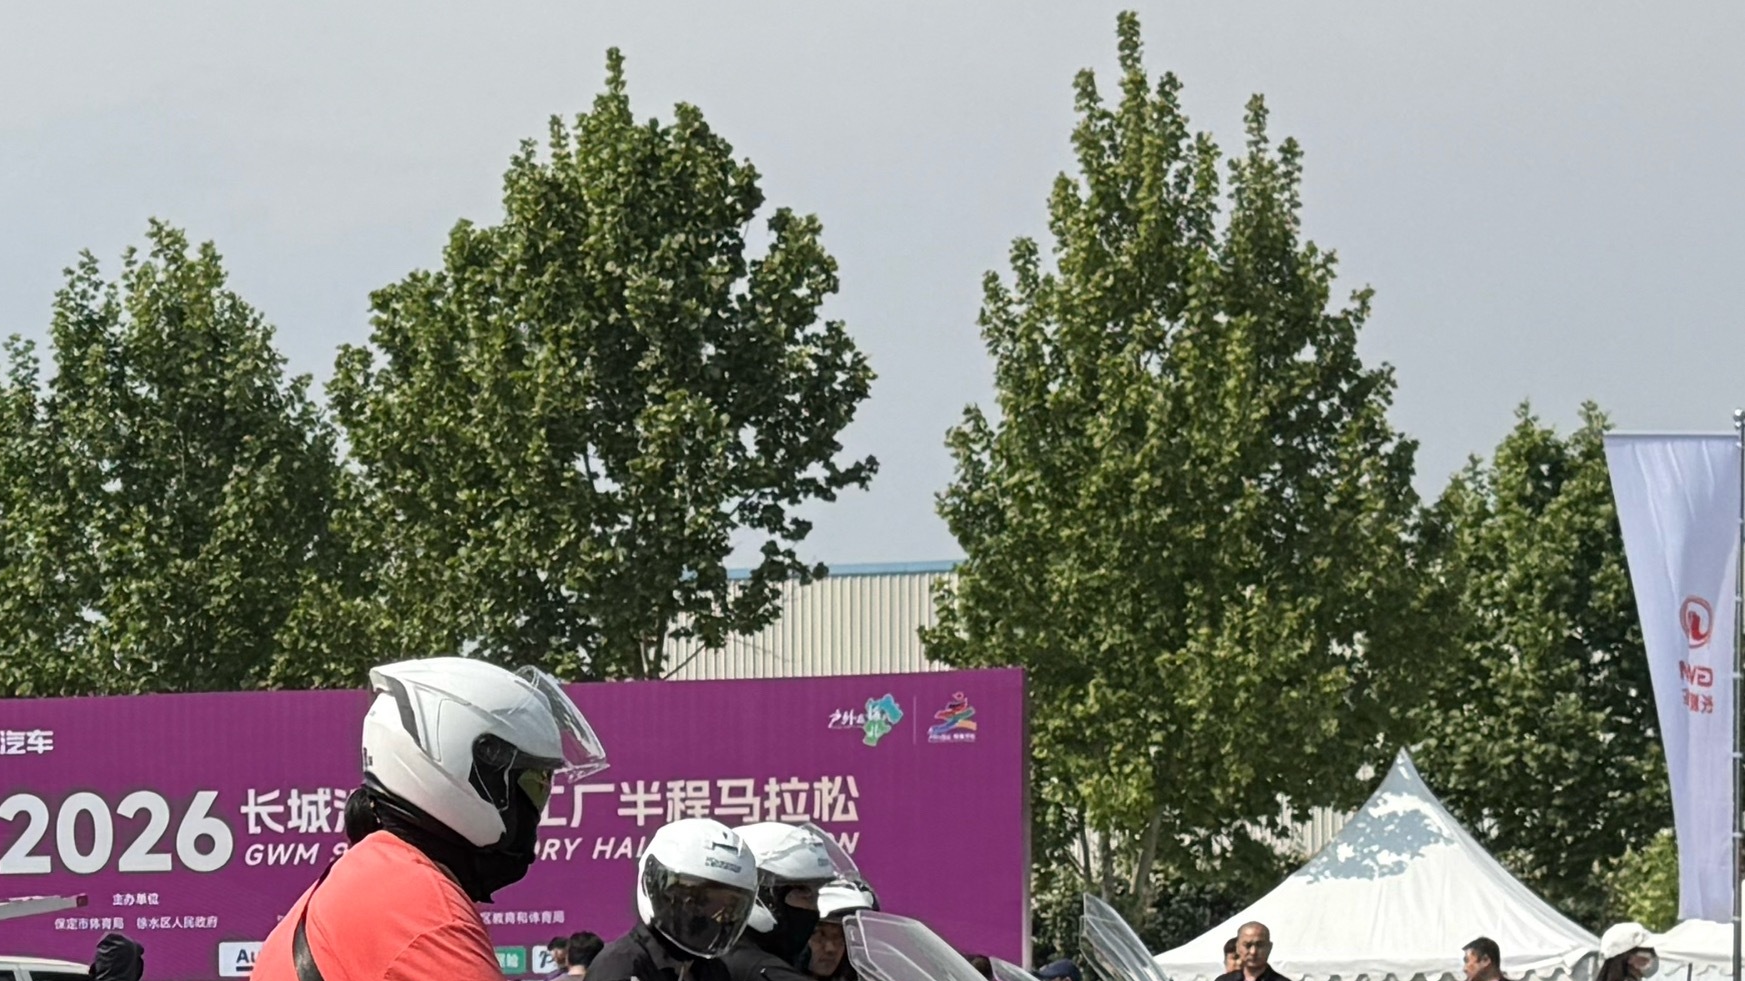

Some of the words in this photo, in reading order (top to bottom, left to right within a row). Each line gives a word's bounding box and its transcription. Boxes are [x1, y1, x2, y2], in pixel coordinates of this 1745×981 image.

[244, 842, 320, 867] GWM
[534, 837, 583, 861] RY
[112, 893, 160, 906] 主办单位
[54, 916, 125, 930] 保定市体育局
[136, 915, 218, 930] 徐水区人民政府
